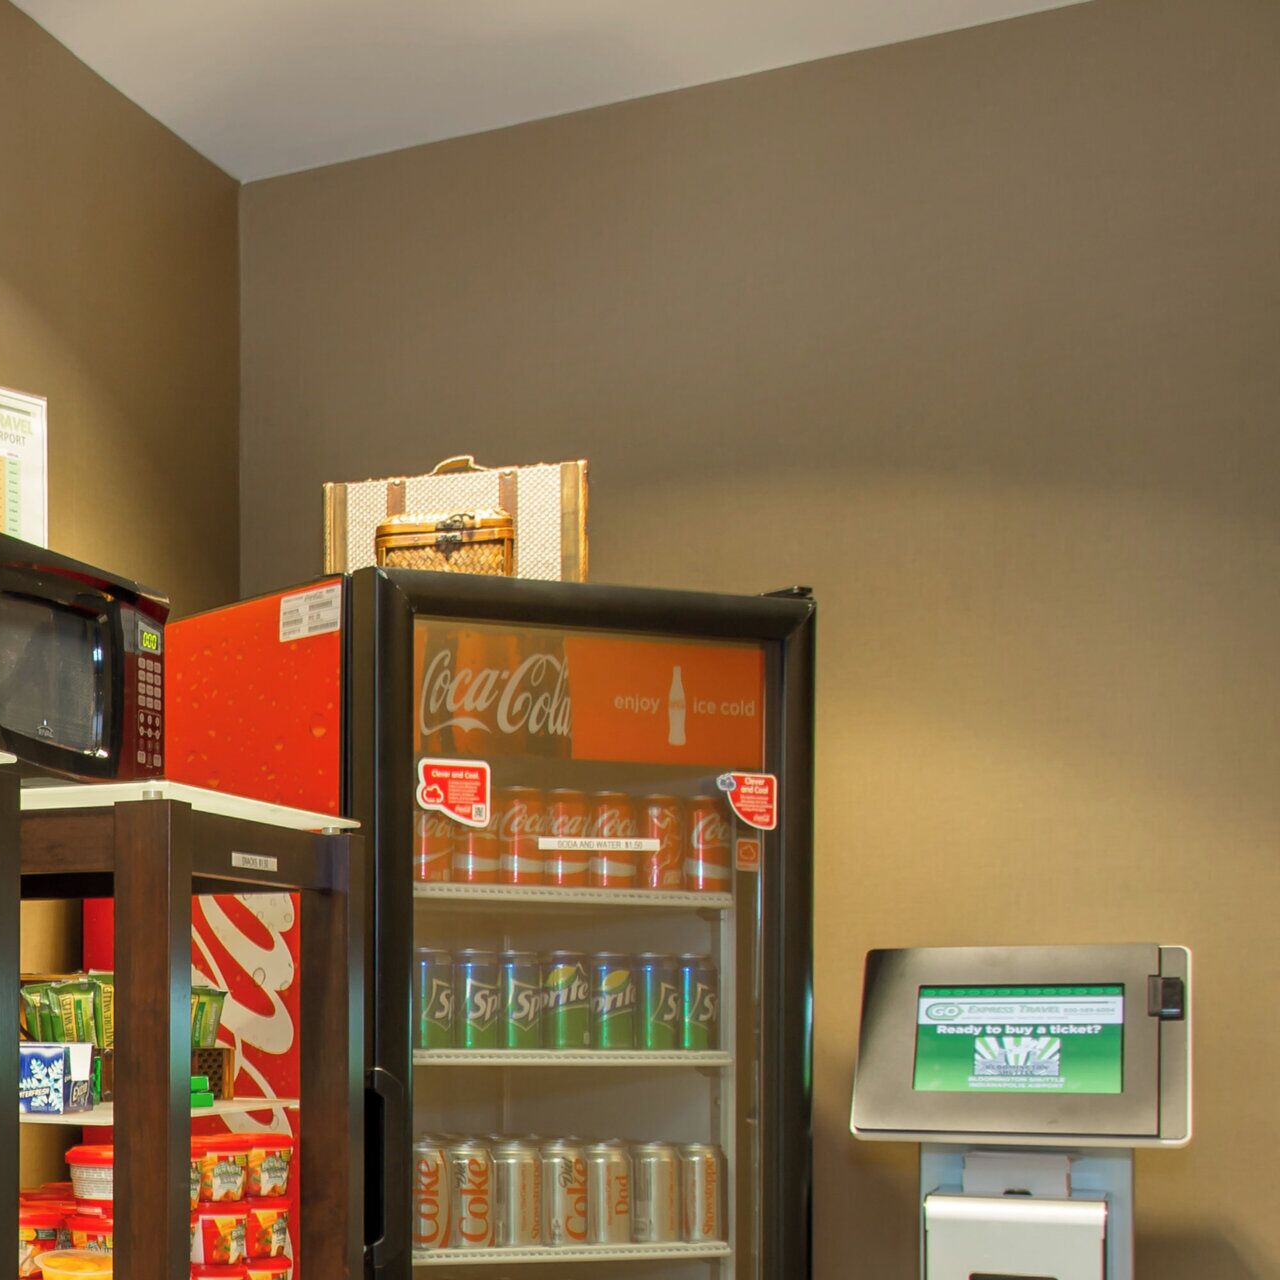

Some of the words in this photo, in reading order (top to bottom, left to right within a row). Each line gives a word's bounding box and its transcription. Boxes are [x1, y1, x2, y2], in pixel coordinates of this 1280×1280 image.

[419, 647, 573, 738] Coca-Cola
[613, 693, 661, 715] enjoy
[692, 697, 717, 716] ice
[719, 698, 756, 718] cold
[579, 840, 595, 850] AND
[596, 840, 622, 850] WATER
[931, 1006, 960, 1018] GO
[1019, 1005, 1062, 1015] TRAVEL
[936, 1024, 983, 1036] Ready
[985, 1025, 1002, 1035] to
[1004, 1024, 1034, 1036] buy
[1036, 1026, 1047, 1035] a
[1050, 1024, 1103, 1035] ticket?
[457, 1157, 490, 1244] Coke
